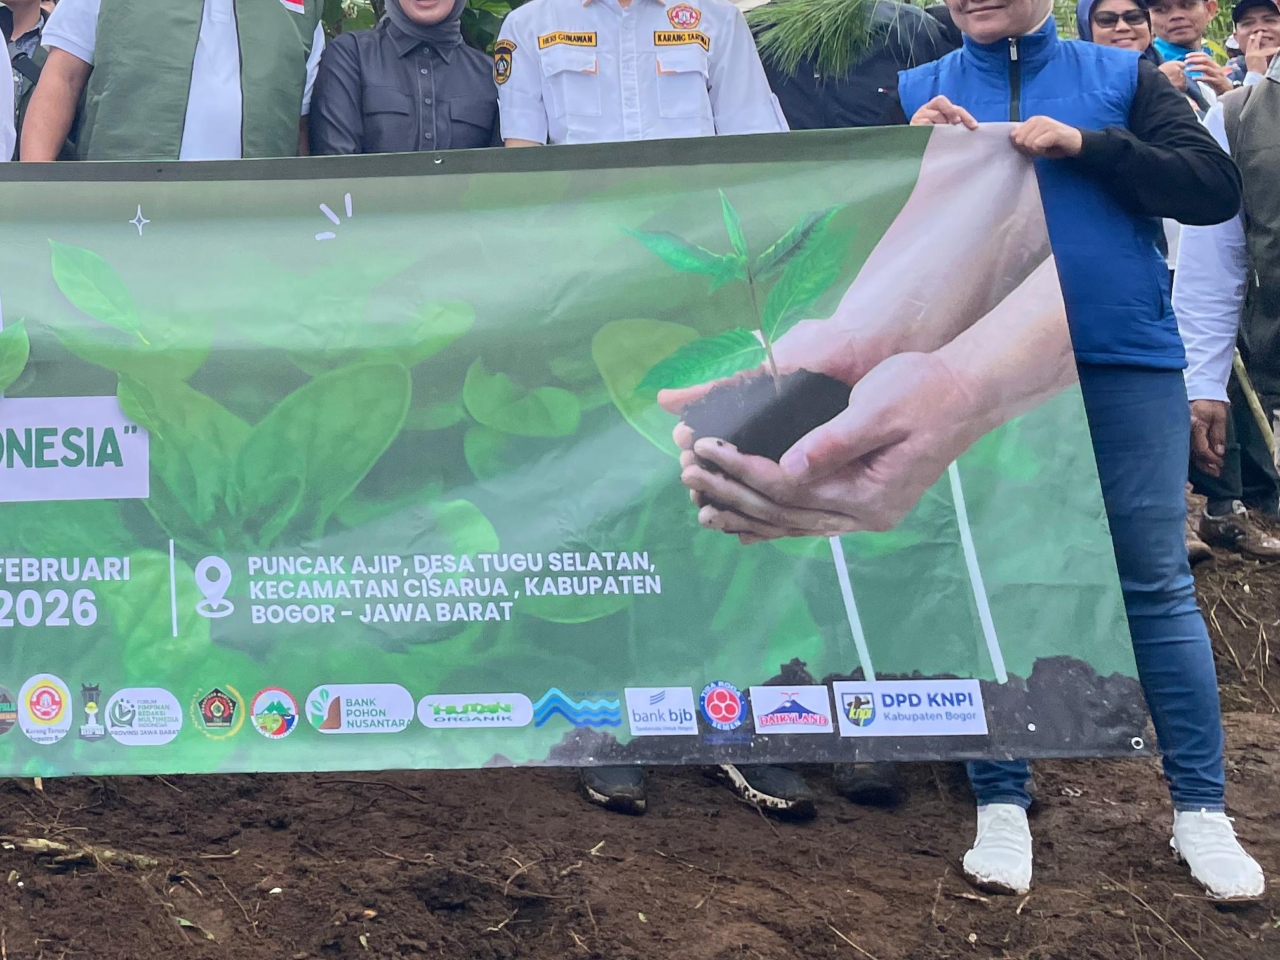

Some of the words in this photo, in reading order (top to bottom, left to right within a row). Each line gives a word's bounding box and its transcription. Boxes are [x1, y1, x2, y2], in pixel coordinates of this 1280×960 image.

[658, 34, 686, 42] KARANG
[248, 555, 346, 576] PUNCAK
[351, 555, 408, 577] AJIP,
[414, 554, 475, 575] DESA
[478, 553, 543, 573] TUGU
[548, 551, 655, 573] SELATAN,
[250, 578, 399, 600] KECAMATAN
[403, 577, 509, 598] CISARUA
[524, 575, 661, 596] KABUPATEN
[251, 604, 335, 624] BOGOR
[359, 603, 431, 623] JAWA
[436, 602, 513, 622] BARAT
[701, 682, 717, 697] TIGA
[718, 681, 741, 697] RODA
[346, 698, 376, 707] BANK
[882, 693, 922, 707] DPD
[927, 692, 973, 707] KNPI
[346, 709, 386, 717] POHON
[632, 709, 666, 722] bank
[669, 708, 693, 724] bjb
[758, 712, 829, 727] DAIRYLAND
[883, 712, 942, 723] Kabupaten
[945, 711, 977, 722] Bogor
[711, 720, 742, 730] SEMEN
